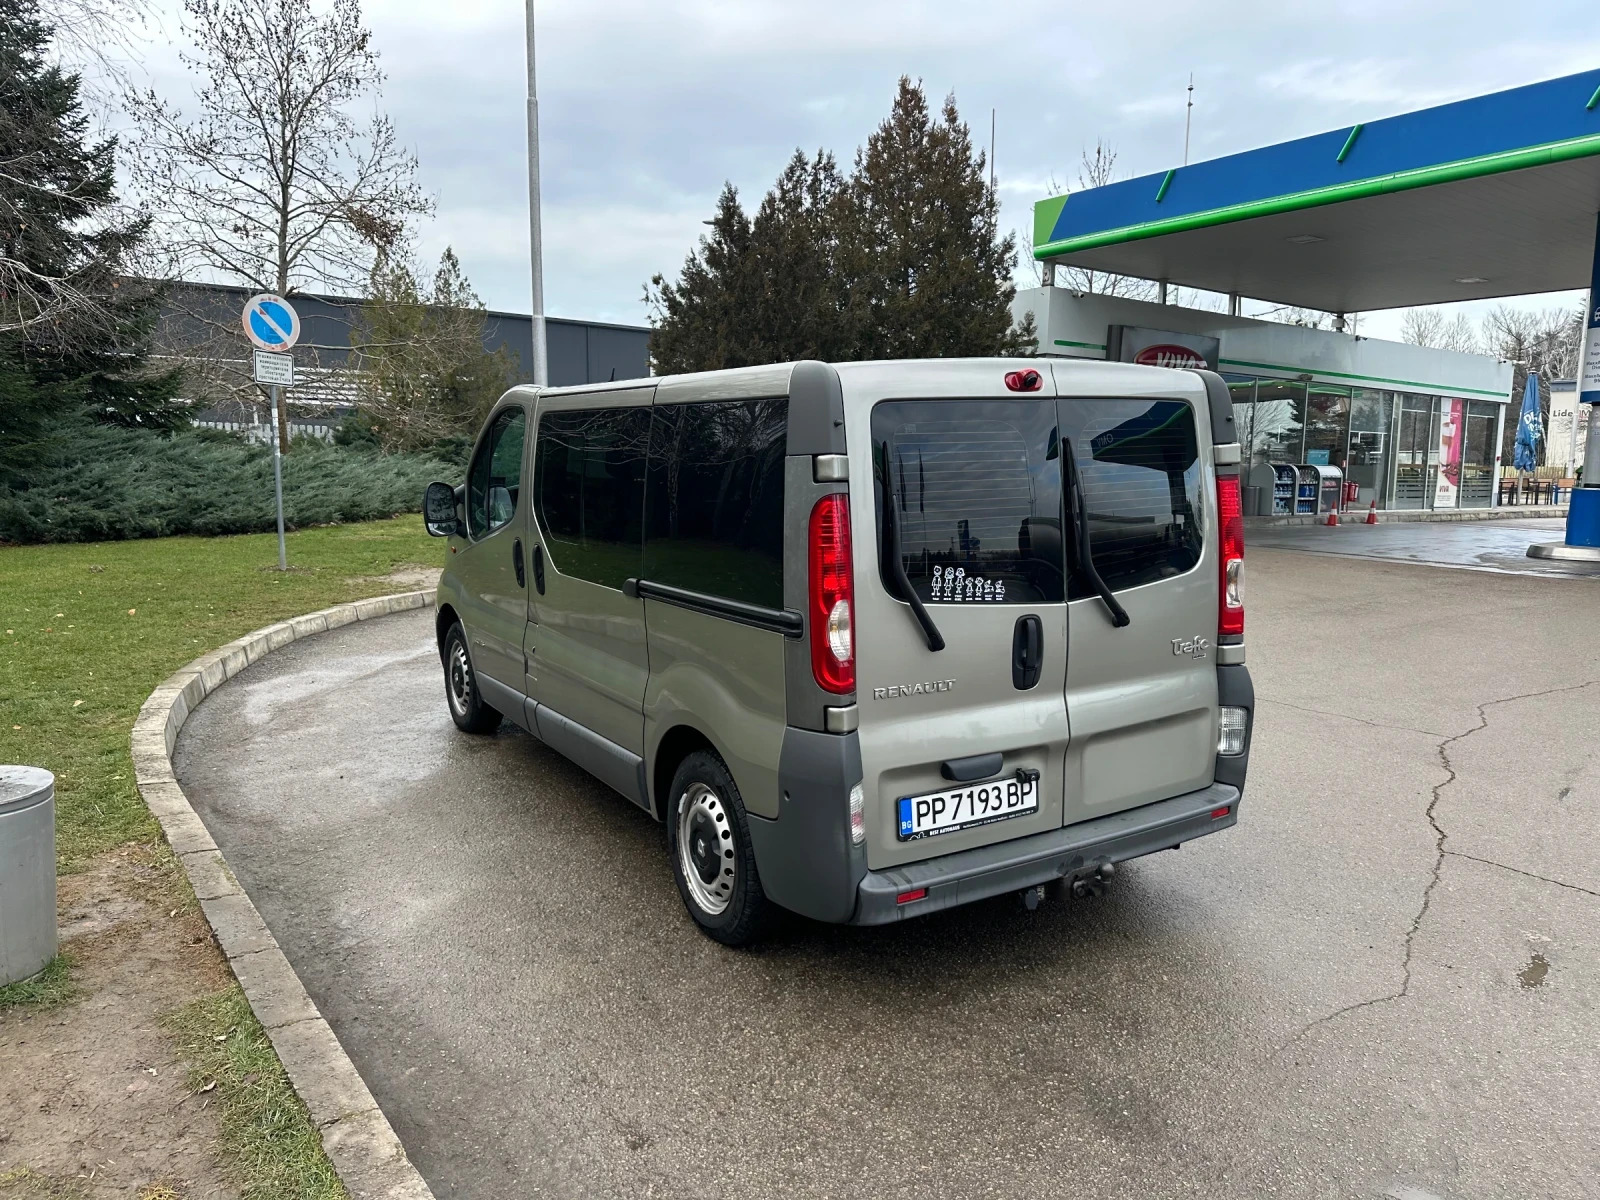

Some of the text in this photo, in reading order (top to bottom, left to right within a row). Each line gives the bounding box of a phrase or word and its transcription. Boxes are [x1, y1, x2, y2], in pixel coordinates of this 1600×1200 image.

[1171, 635, 1210, 656] Trafic
[874, 678, 956, 700] RENAULT
[902, 820, 912, 830] BG
[916, 797, 946, 828] PP
[951, 786, 1002, 820] 7193
[1007, 780, 1033, 808] BP
